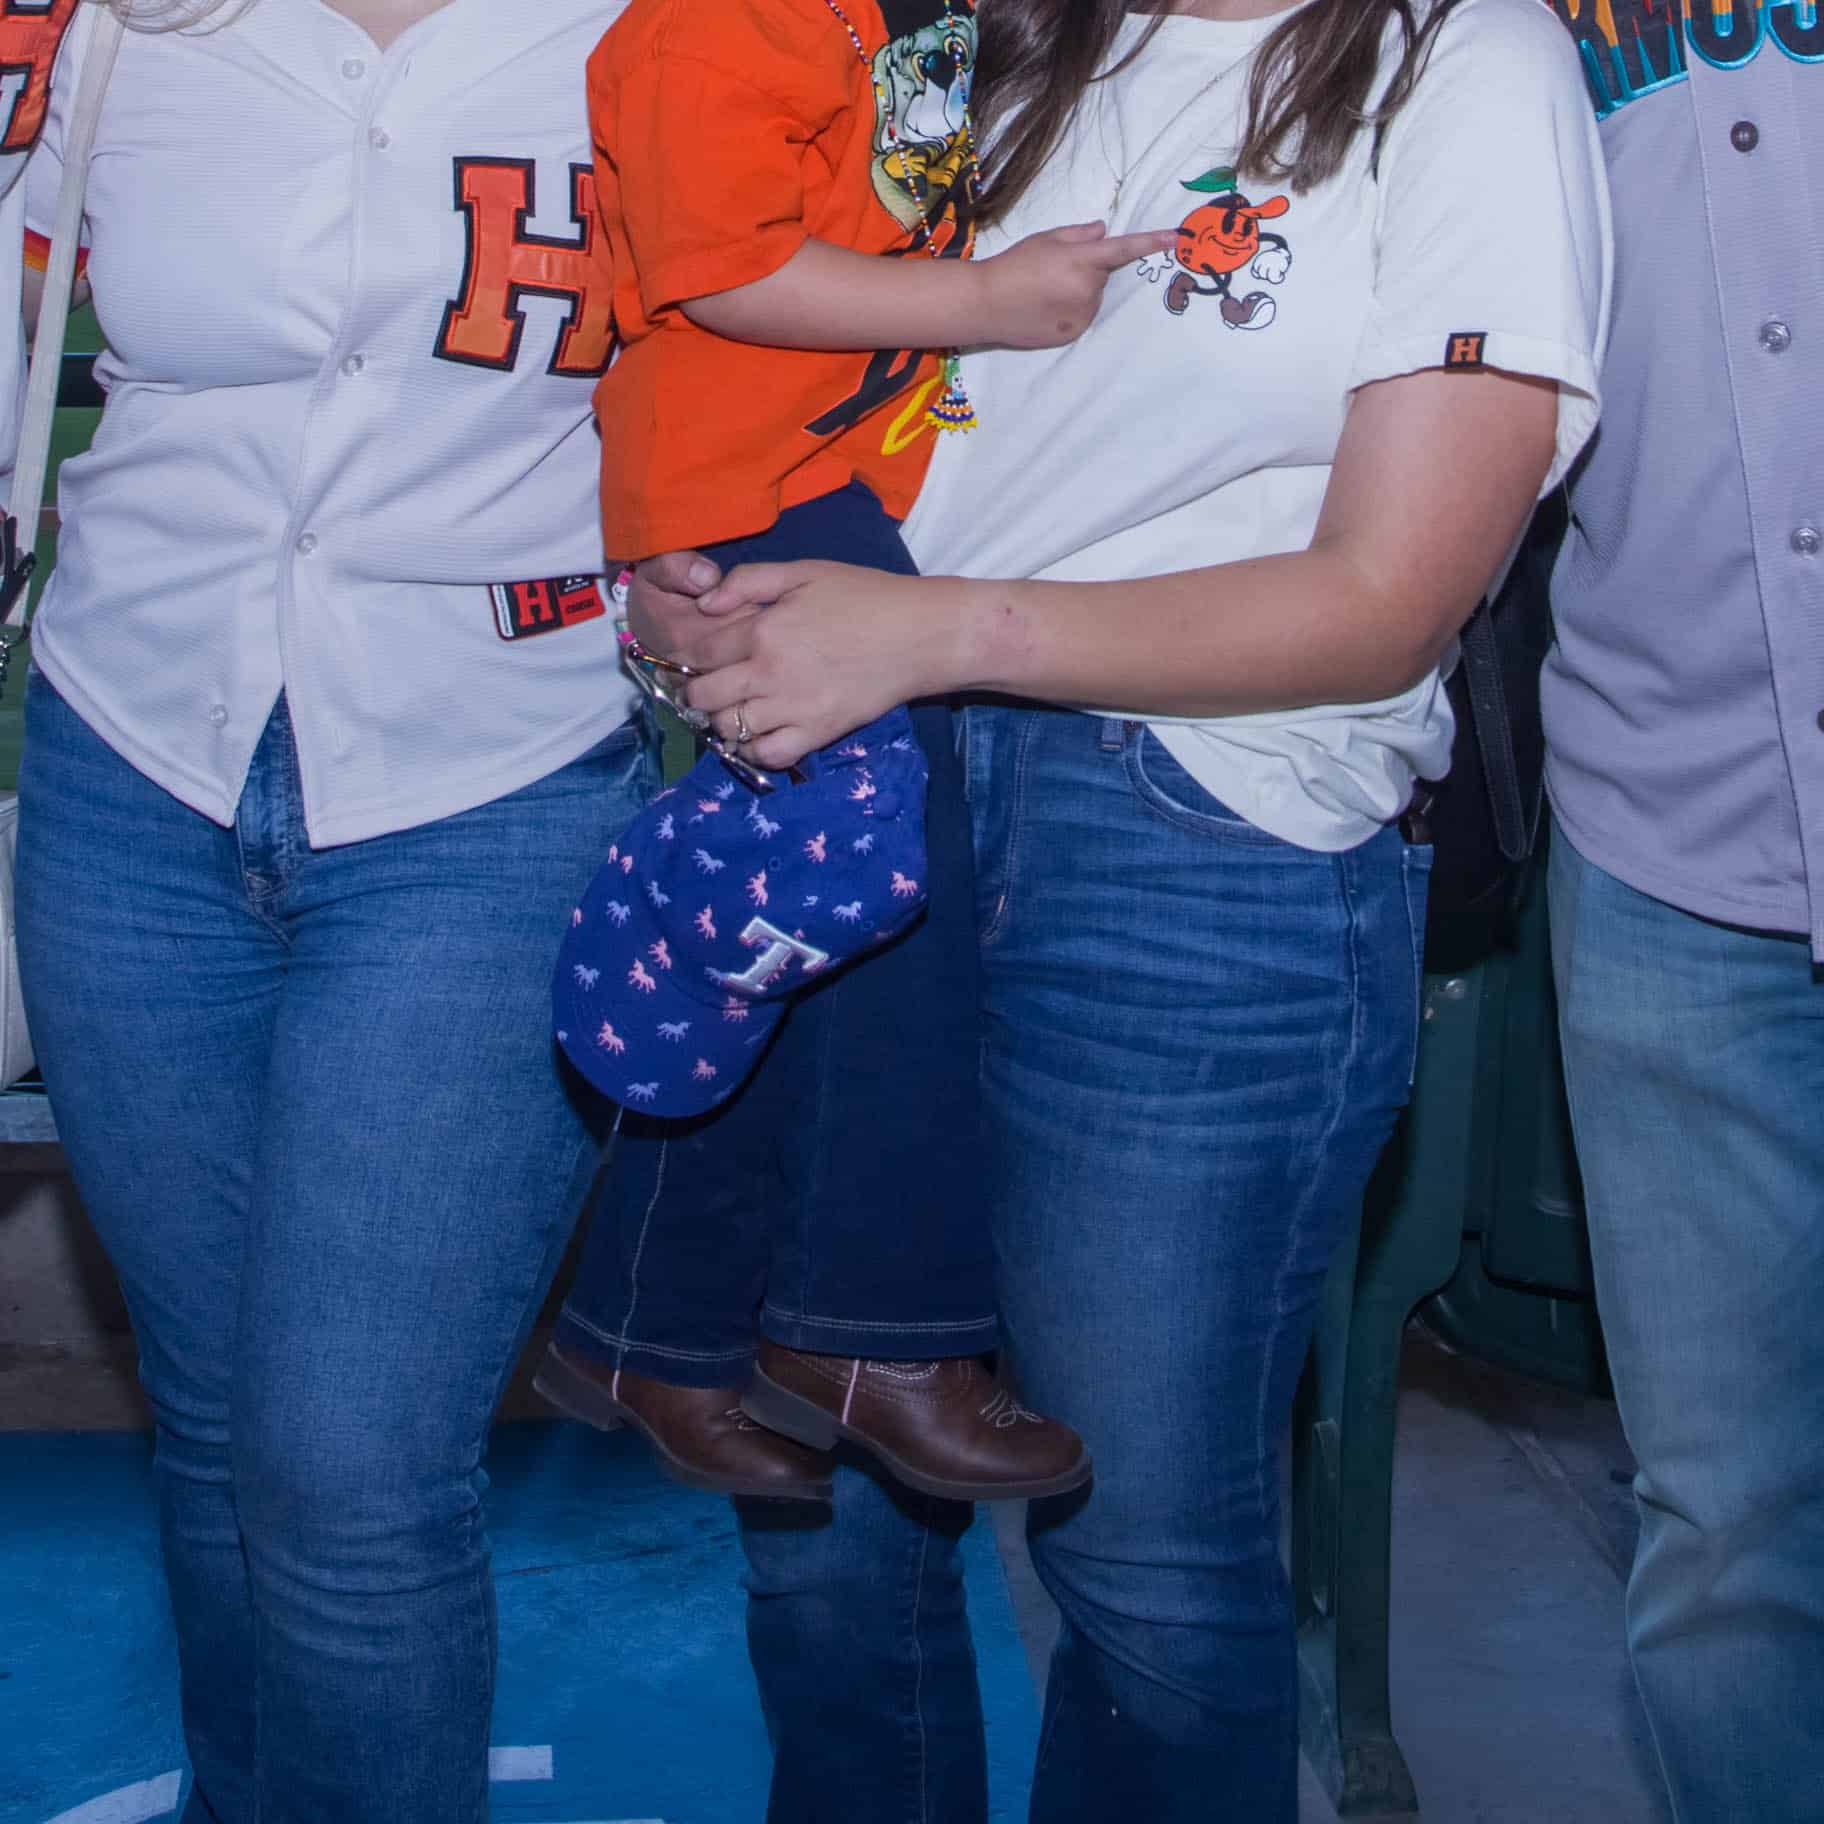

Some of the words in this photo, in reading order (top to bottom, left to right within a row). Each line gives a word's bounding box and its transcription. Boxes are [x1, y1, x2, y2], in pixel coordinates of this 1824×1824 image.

[432, 155, 618, 378] H
[513, 580, 555, 626] H
[727, 915, 830, 993] T
